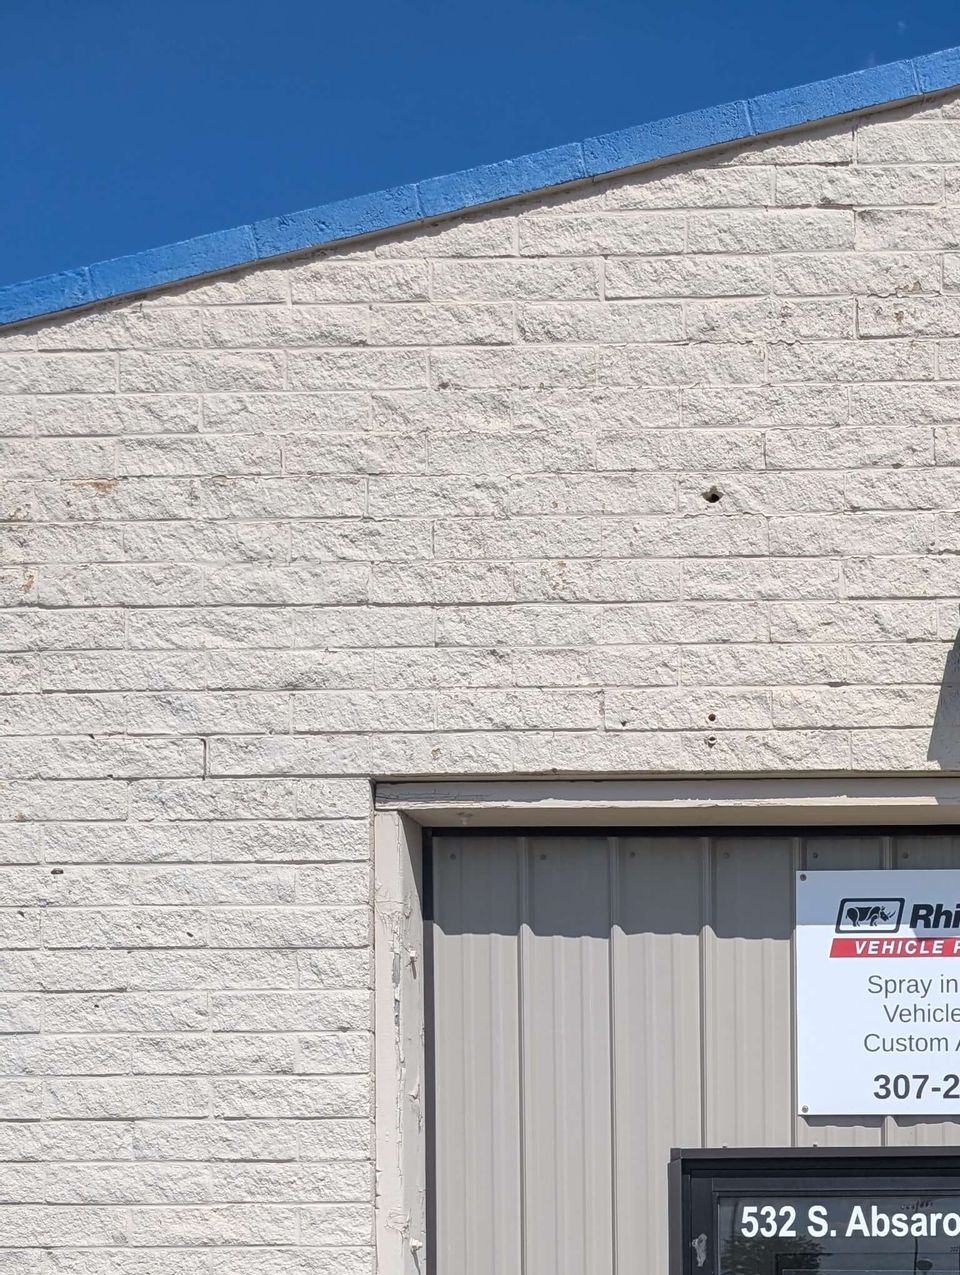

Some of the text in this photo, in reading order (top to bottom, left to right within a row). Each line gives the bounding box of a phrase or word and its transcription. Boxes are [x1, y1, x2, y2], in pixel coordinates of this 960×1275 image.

[855, 940, 945, 955] VEHICLE
[868, 975, 932, 998] Spray
[941, 974, 957, 992] in
[864, 1034, 948, 1052] Custom
[741, 1206, 796, 1237] 532
[808, 1206, 836, 1237] S.
